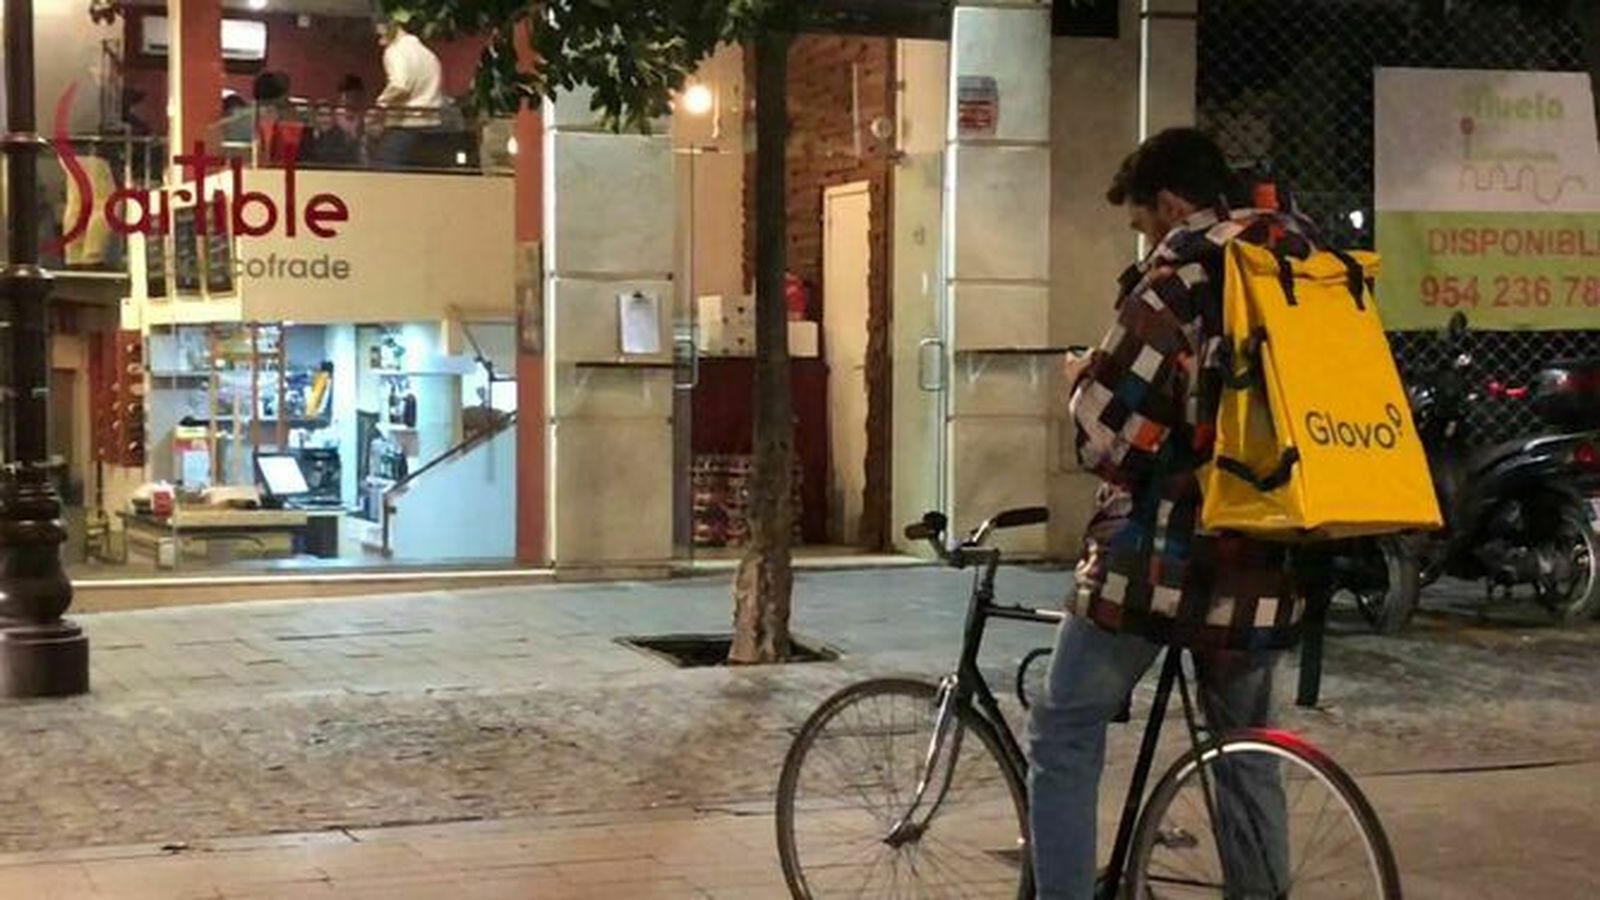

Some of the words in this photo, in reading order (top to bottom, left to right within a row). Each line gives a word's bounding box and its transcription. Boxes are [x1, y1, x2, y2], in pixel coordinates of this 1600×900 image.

[41, 80, 349, 256] Sartible
[1428, 229, 1600, 256] DISPONIBL
[1420, 275, 1480, 308] 954
[1493, 275, 1551, 307] 236
[1305, 411, 1396, 449] Glovo
